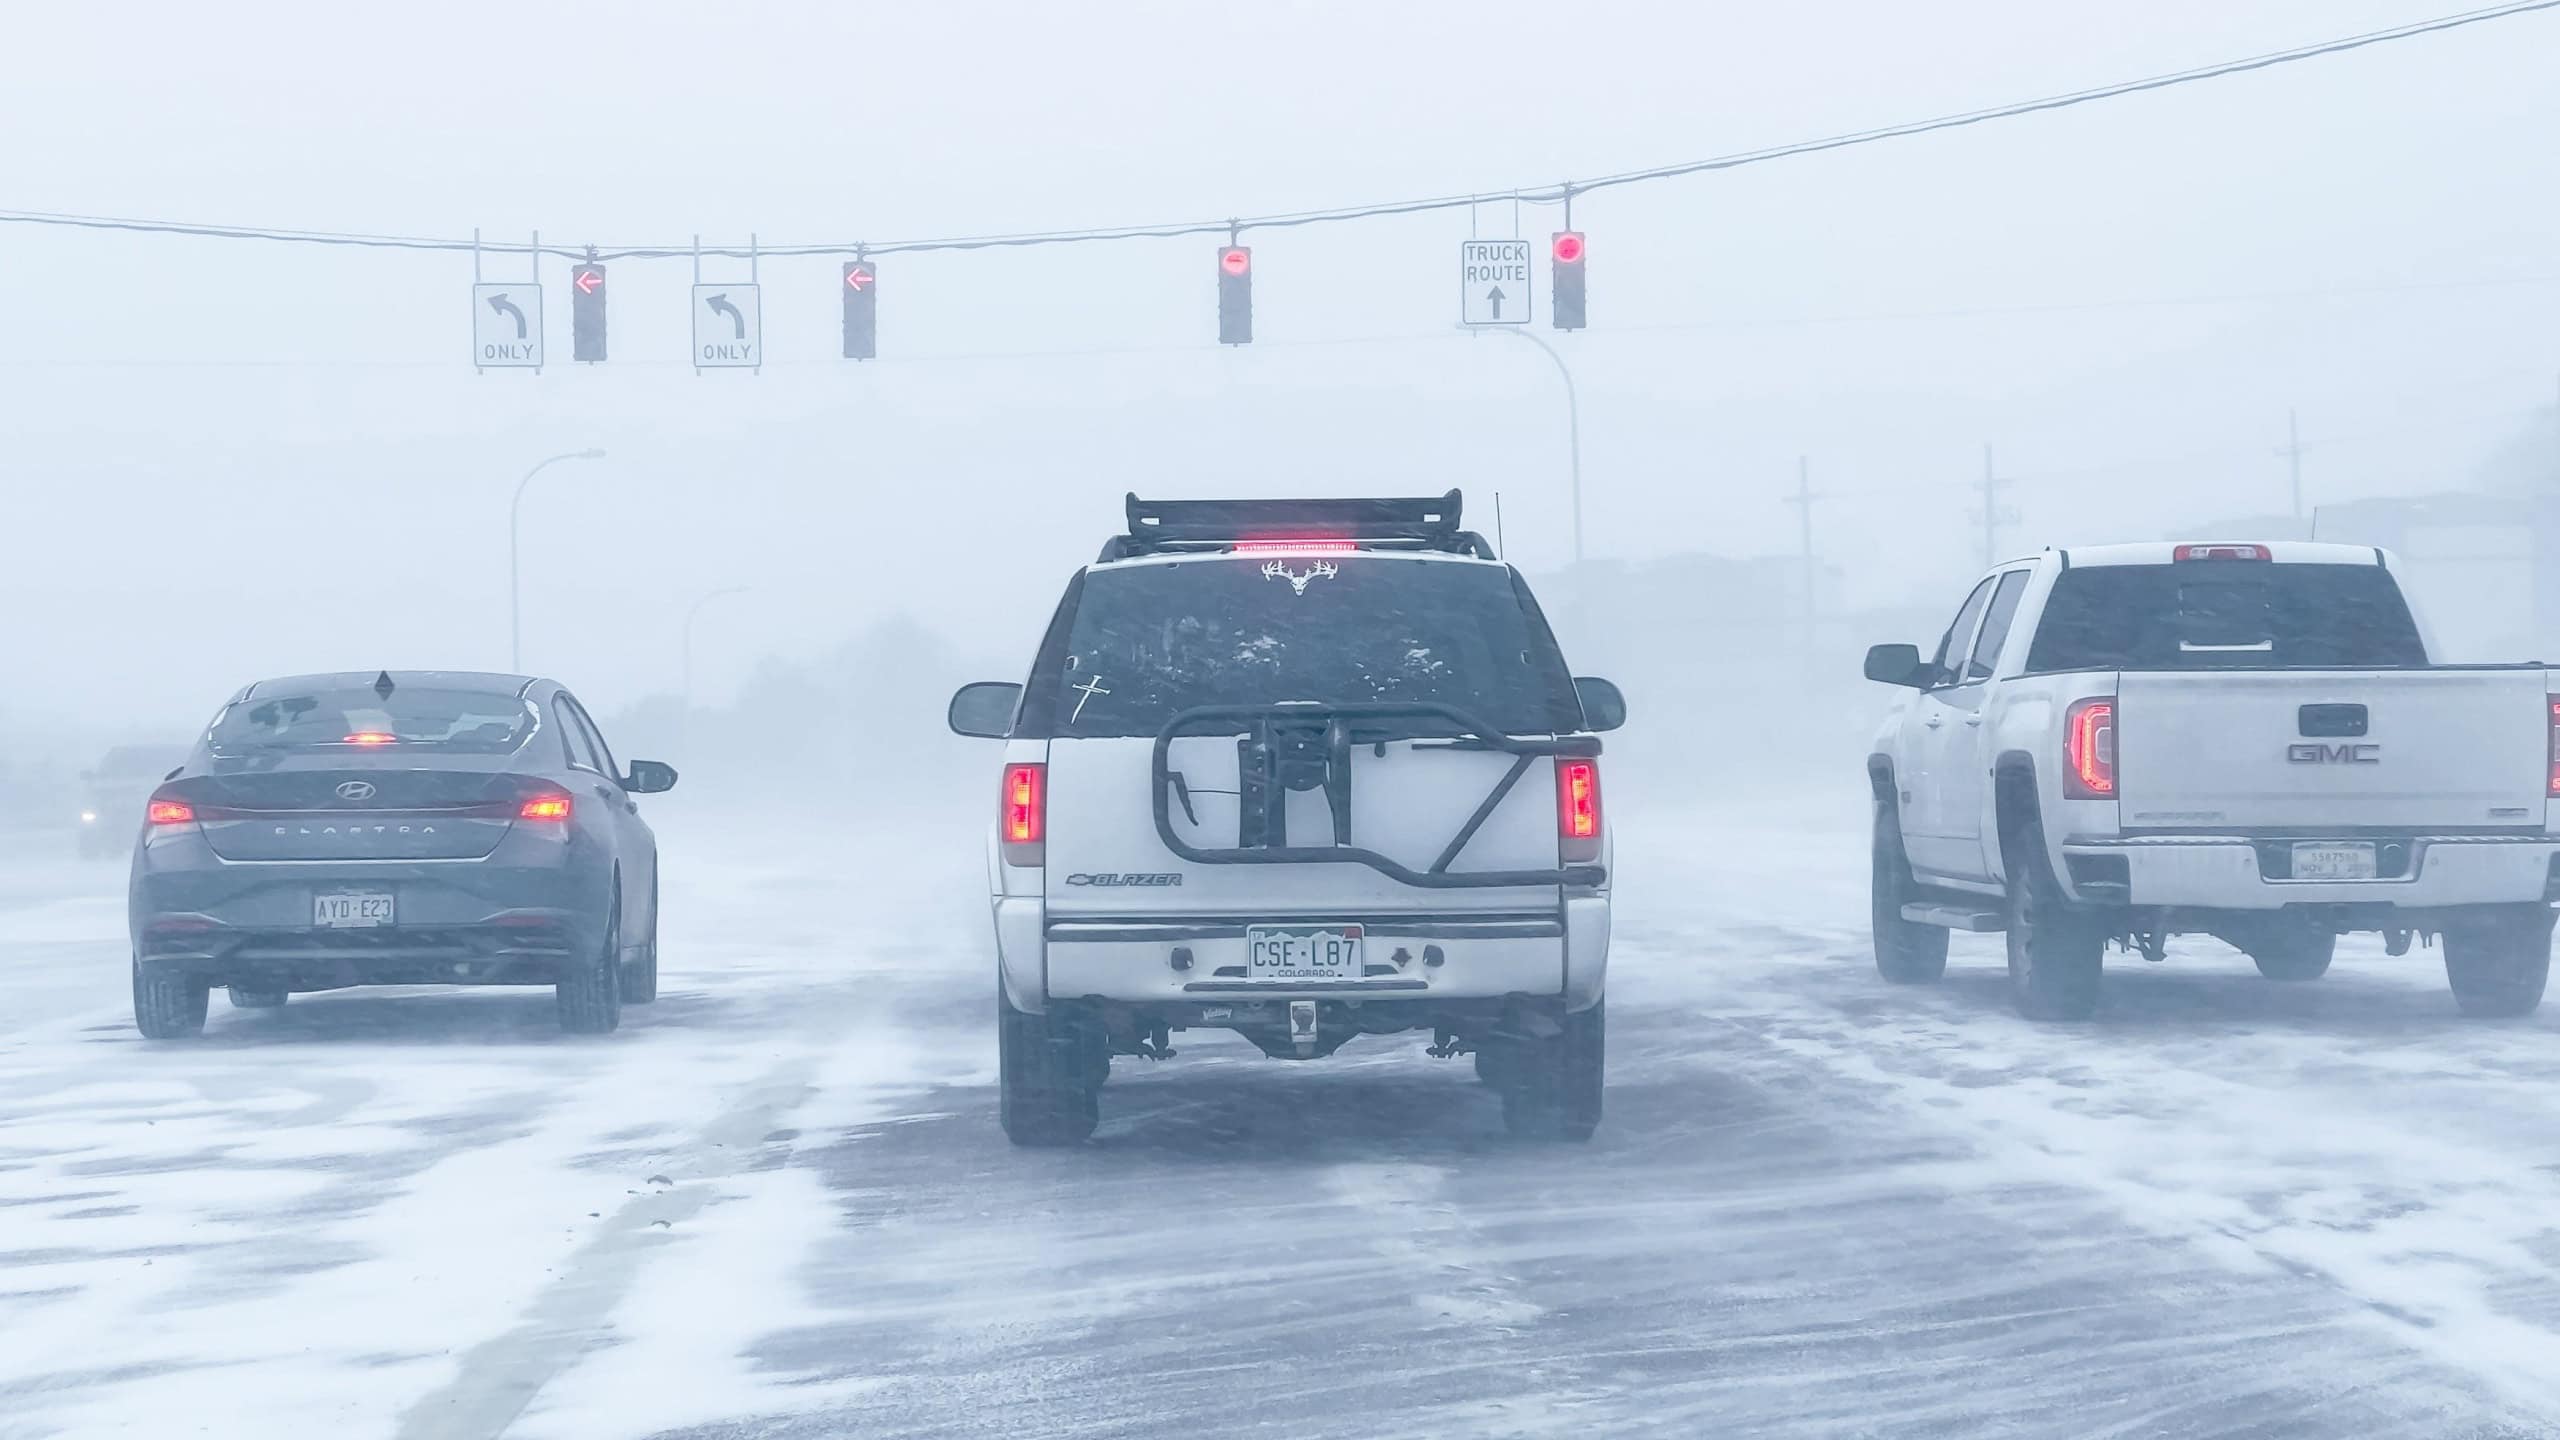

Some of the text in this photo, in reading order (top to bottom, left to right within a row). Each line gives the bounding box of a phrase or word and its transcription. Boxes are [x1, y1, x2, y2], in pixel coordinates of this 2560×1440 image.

[1467, 246, 1524, 261] TRUCK
[1467, 265, 1525, 281] ROUTE
[484, 344, 533, 360] ONLY
[703, 344, 752, 360] ONLY
[2287, 744, 2380, 764] GMC
[1093, 873, 1182, 886] BLAZER
[1278, 969, 1335, 977] COLORADO
